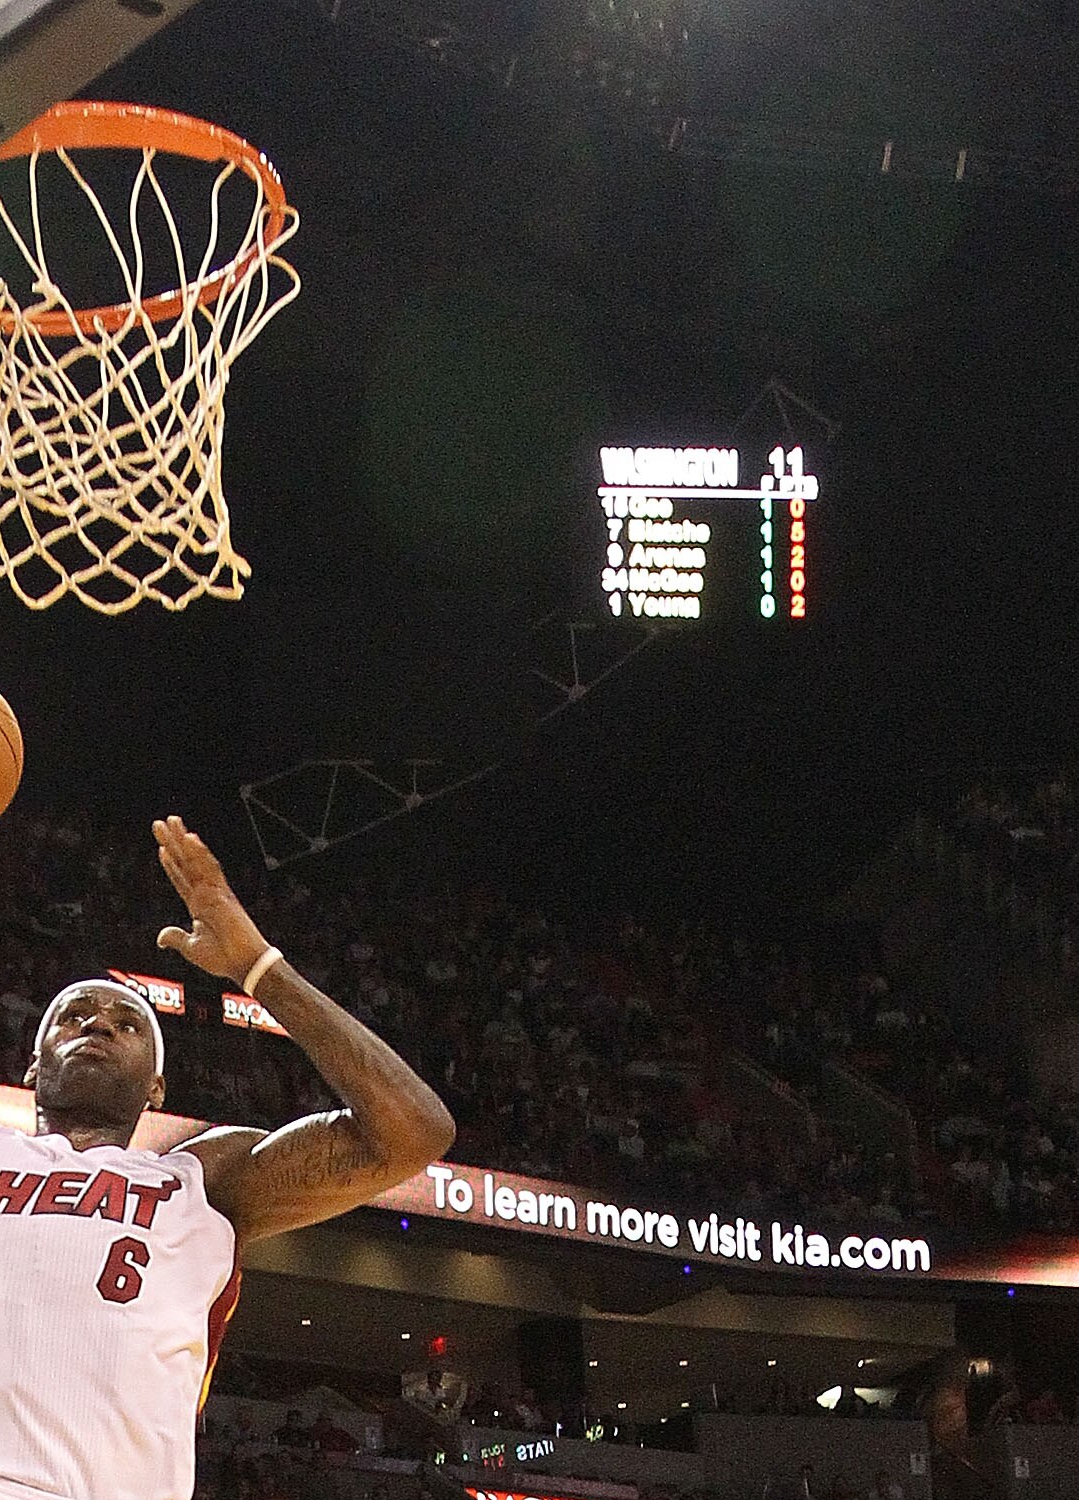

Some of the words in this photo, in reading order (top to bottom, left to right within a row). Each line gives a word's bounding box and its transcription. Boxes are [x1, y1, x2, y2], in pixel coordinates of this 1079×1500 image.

[599, 446, 738, 487] WASHINGTON
[768, 446, 804, 479] 11
[789, 496, 805, 519] 0
[760, 520, 772, 543] 1
[760, 545, 772, 568] 1
[790, 546, 806, 569] 2
[760, 570, 772, 592] 1
[789, 568, 805, 592] 0
[760, 593, 775, 618] 0
[790, 594, 806, 619] 2
[224, 997, 283, 1031] BACA
[427, 1166, 474, 1213] To
[484, 1175, 577, 1231] learn
[586, 1199, 679, 1248] more
[688, 1212, 761, 1262] visit
[771, 1221, 932, 1273] kia.com
[96, 1235, 151, 1305] 6
